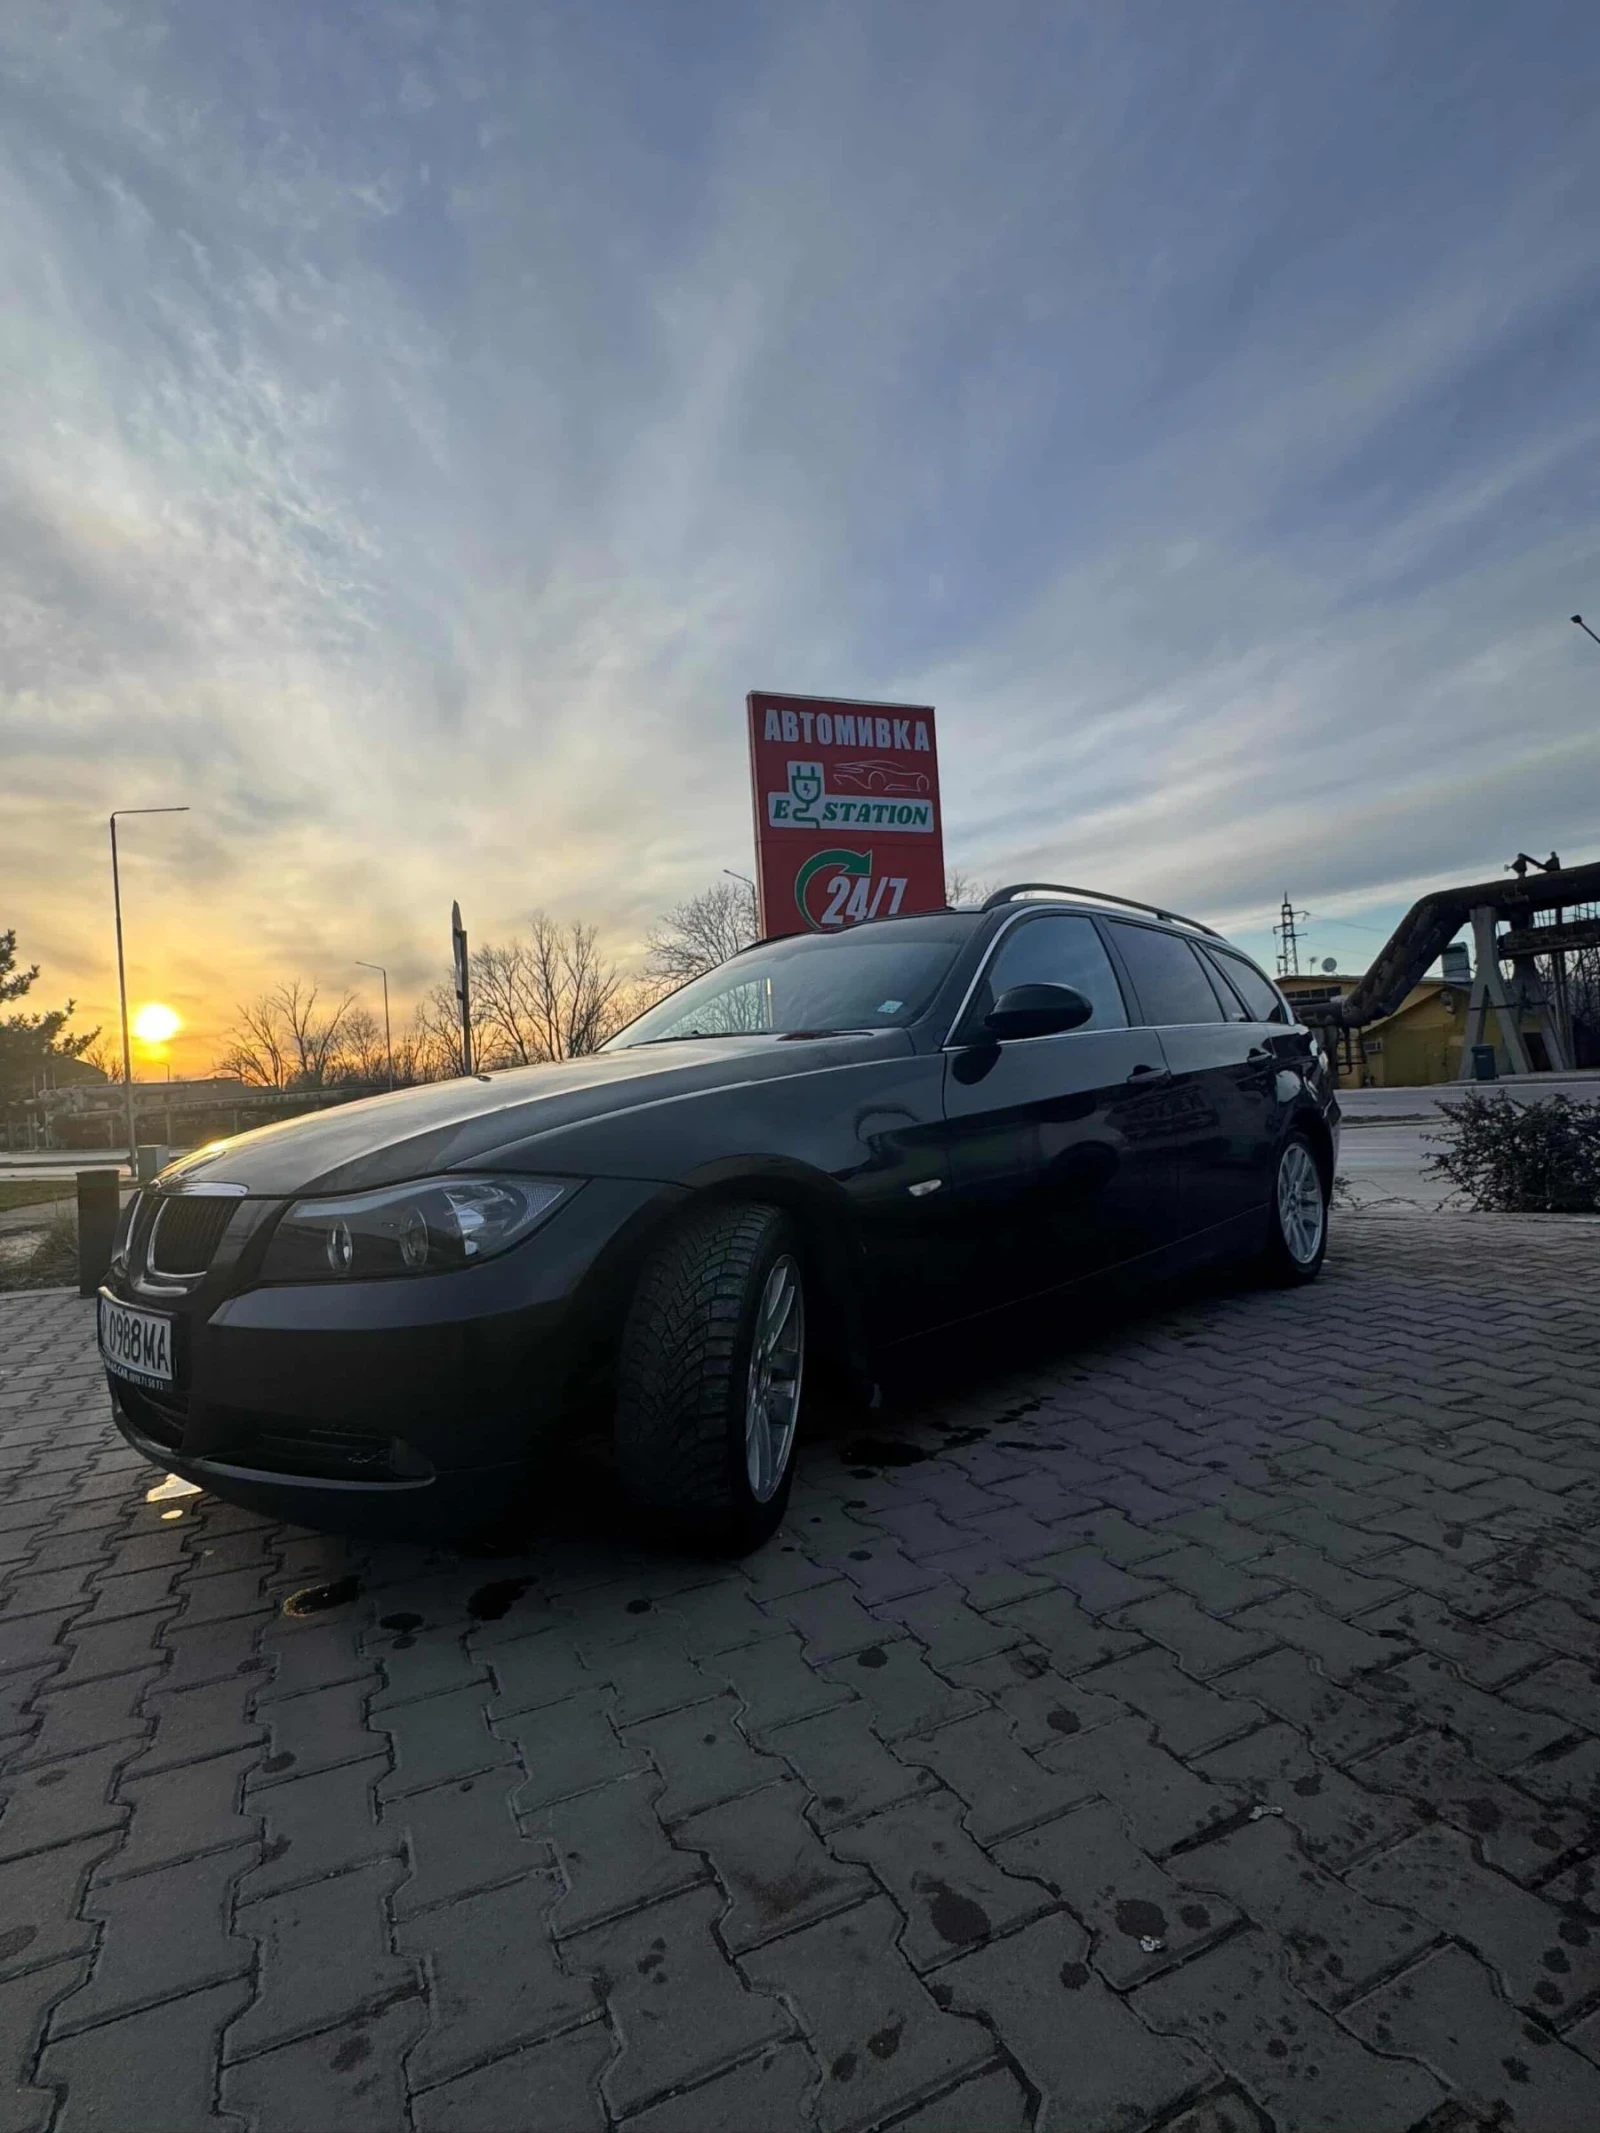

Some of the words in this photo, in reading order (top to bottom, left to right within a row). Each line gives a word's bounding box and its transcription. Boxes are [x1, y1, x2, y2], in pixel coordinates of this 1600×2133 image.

[764, 709, 930, 751] АВТОМИВКА
[773, 800, 790, 819] E
[822, 802, 929, 825] STATION
[821, 876, 908, 924] 24/7
